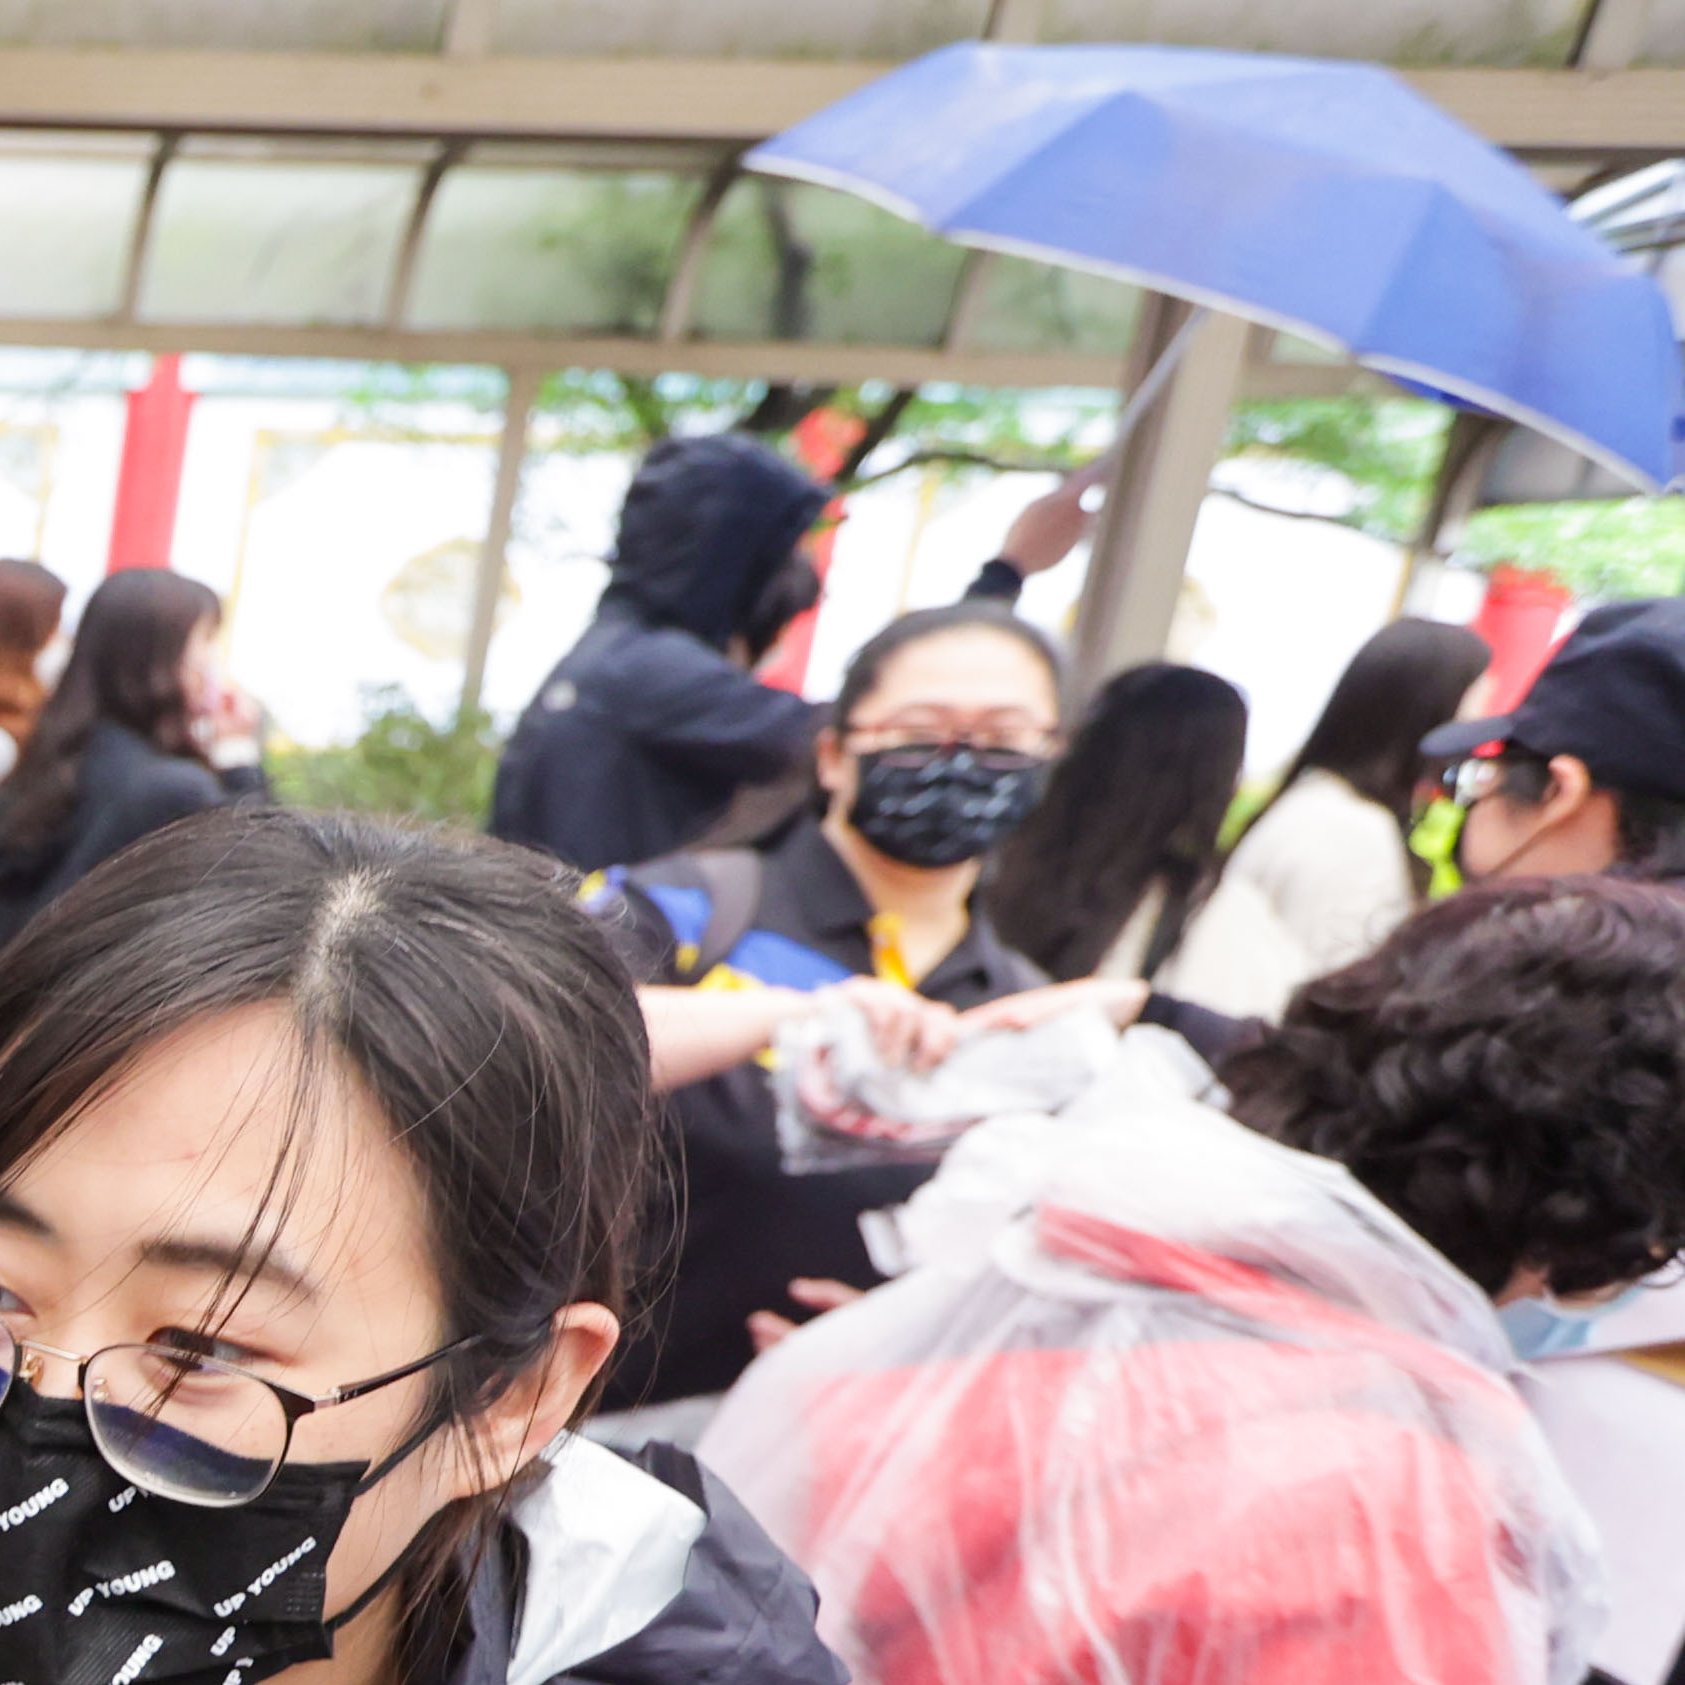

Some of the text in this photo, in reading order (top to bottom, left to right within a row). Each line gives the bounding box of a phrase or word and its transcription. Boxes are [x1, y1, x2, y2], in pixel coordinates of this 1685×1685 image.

[108, 1486, 137, 1513] UP
[68, 1559, 176, 1617] UP YOUNG
[214, 1536, 317, 1617] UP YOUNG
[210, 1626, 236, 1657] UP
